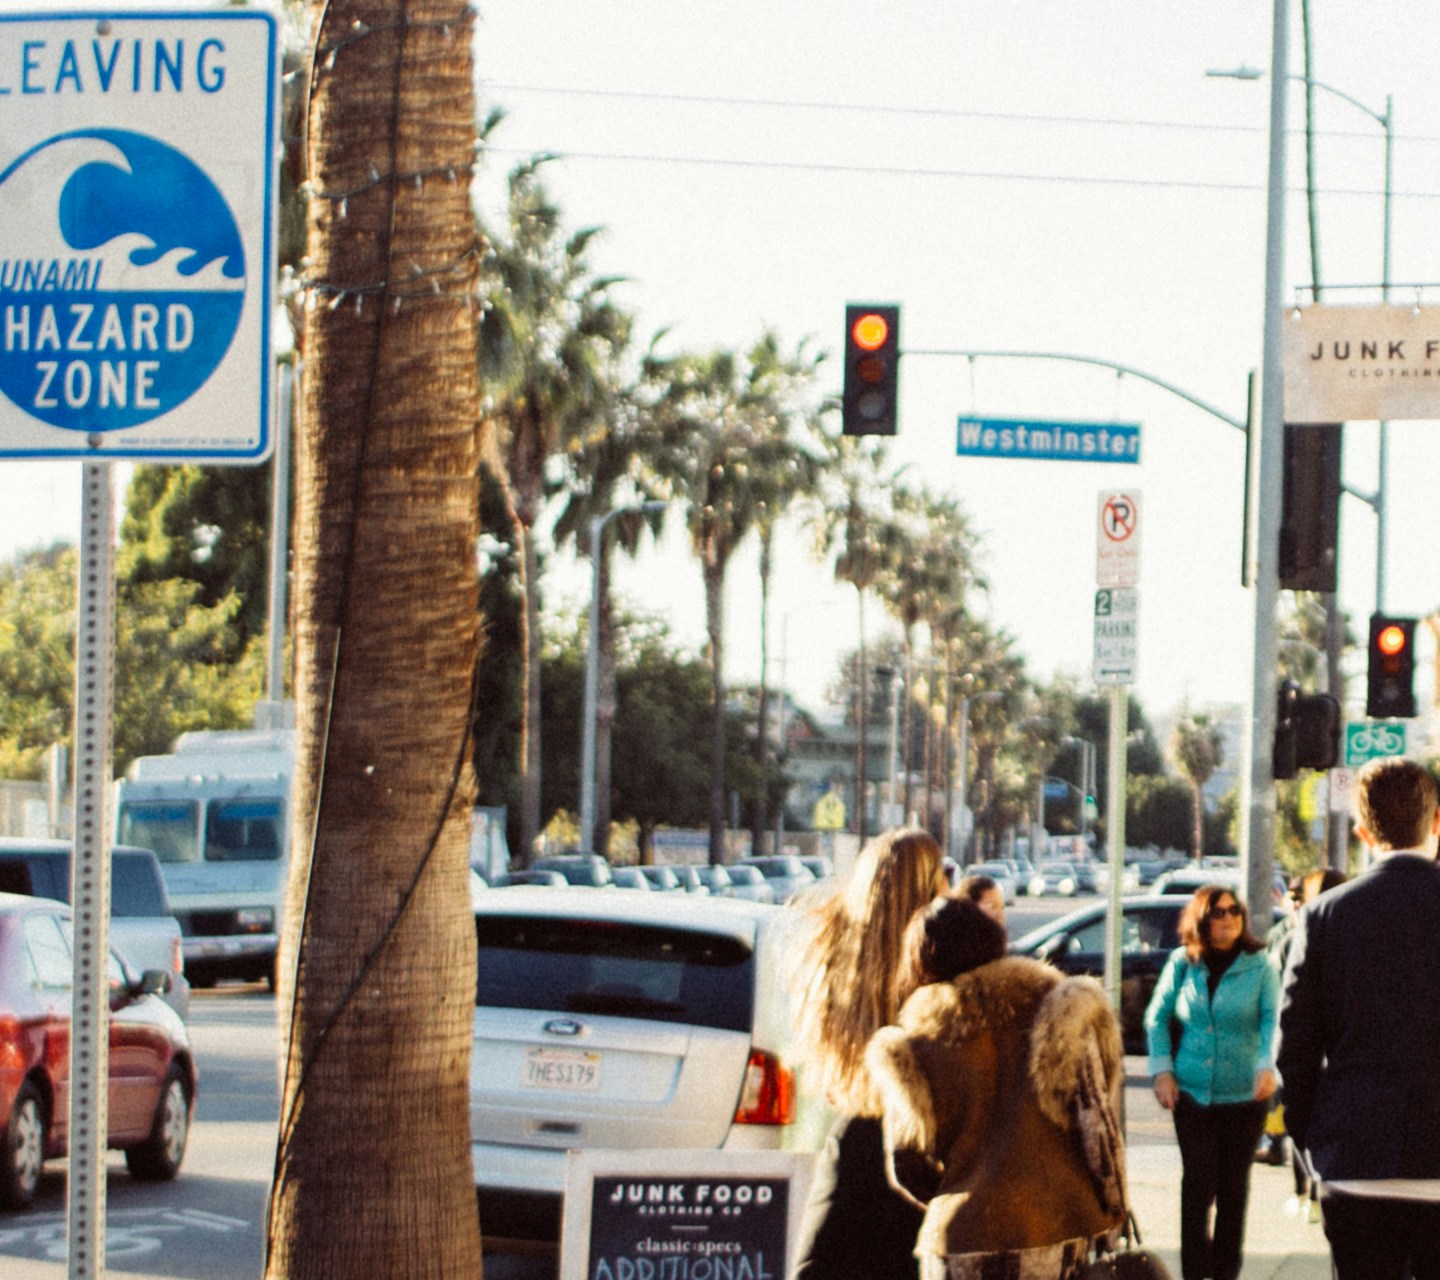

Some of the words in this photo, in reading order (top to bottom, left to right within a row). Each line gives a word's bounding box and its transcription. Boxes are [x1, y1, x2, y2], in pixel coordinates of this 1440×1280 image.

[4, 304, 195, 352] HAZARD
[1310, 340, 1406, 361] JUNK
[34, 360, 162, 409] ZONE
[958, 420, 1140, 456] Westminster
[1096, 591, 1109, 614] 2
[610, 1183, 685, 1203] JUNK
[696, 1185, 774, 1204] FOOD
[639, 1206, 713, 1216] CLOTHING
[722, 1206, 743, 1216] CO
